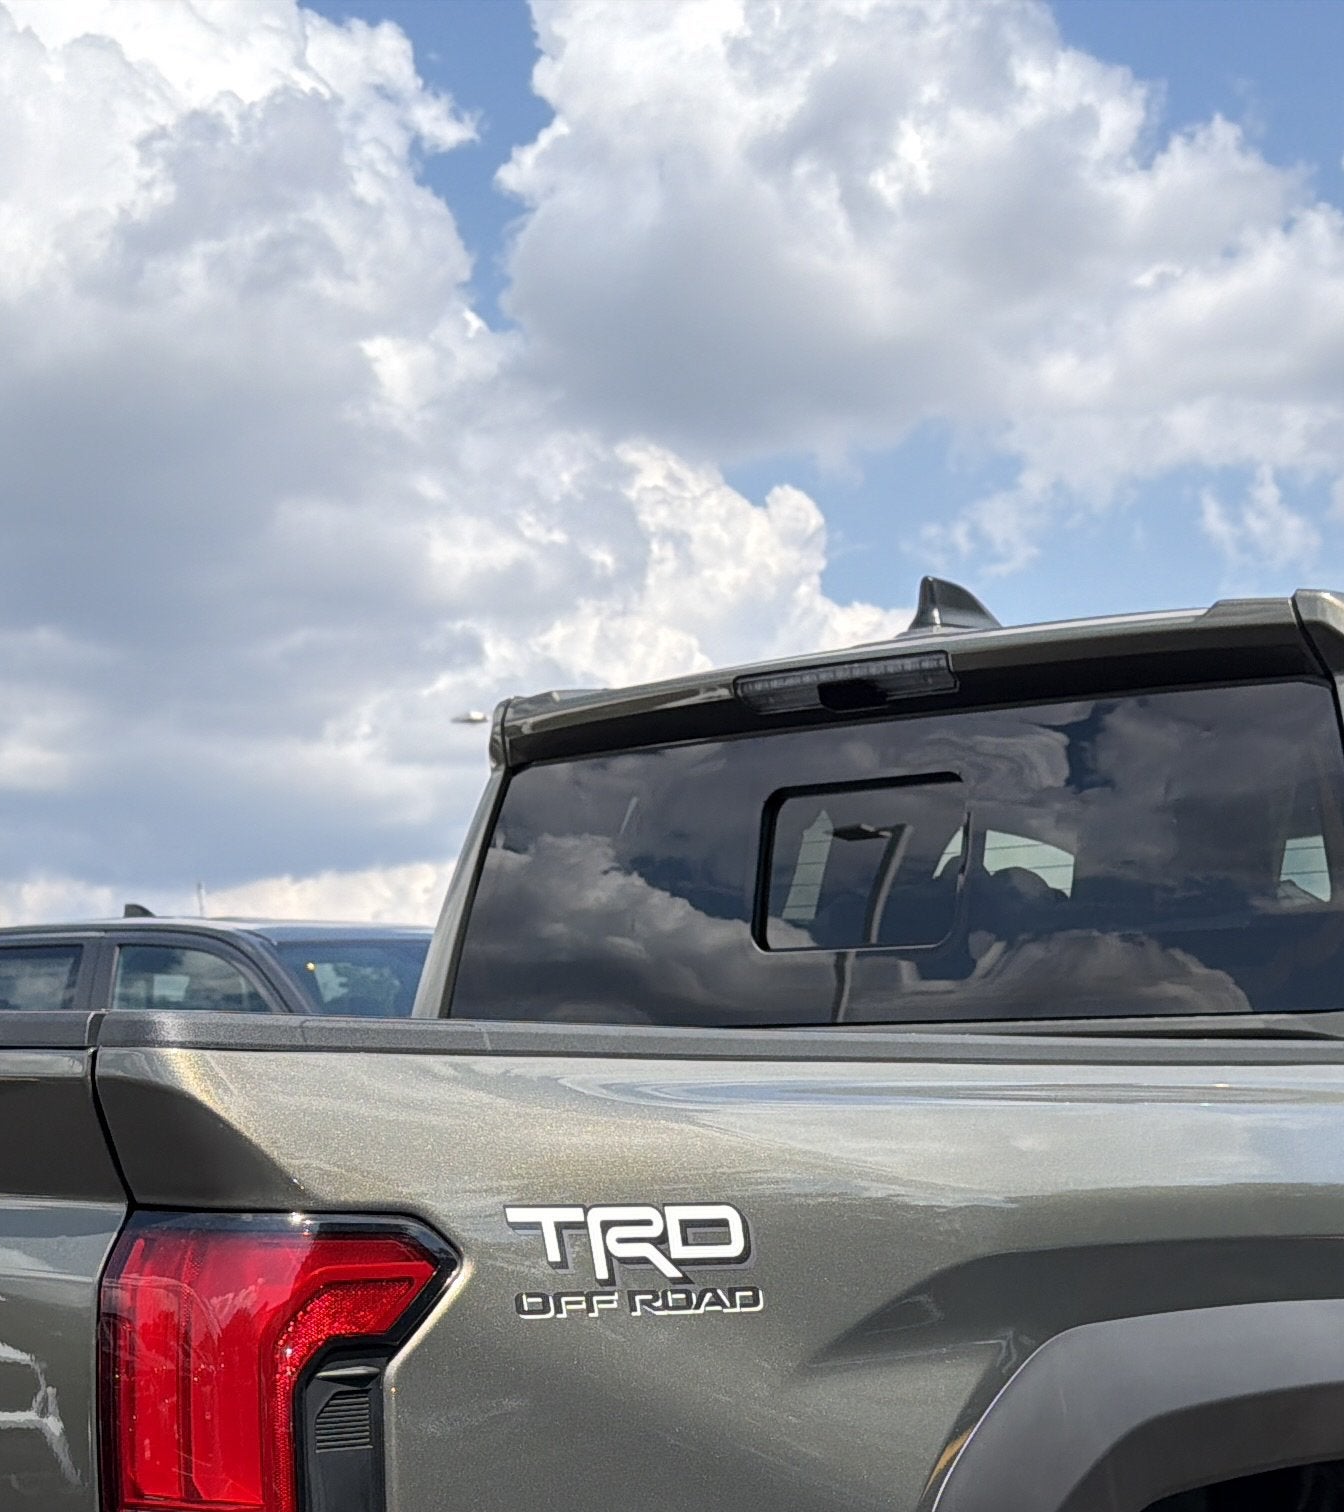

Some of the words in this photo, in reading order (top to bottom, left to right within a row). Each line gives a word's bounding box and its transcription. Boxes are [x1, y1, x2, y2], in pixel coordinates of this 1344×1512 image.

[504, 1203, 752, 1286] TRD
[514, 1290, 619, 1320] OFF
[627, 1286, 764, 1317] ROAD
